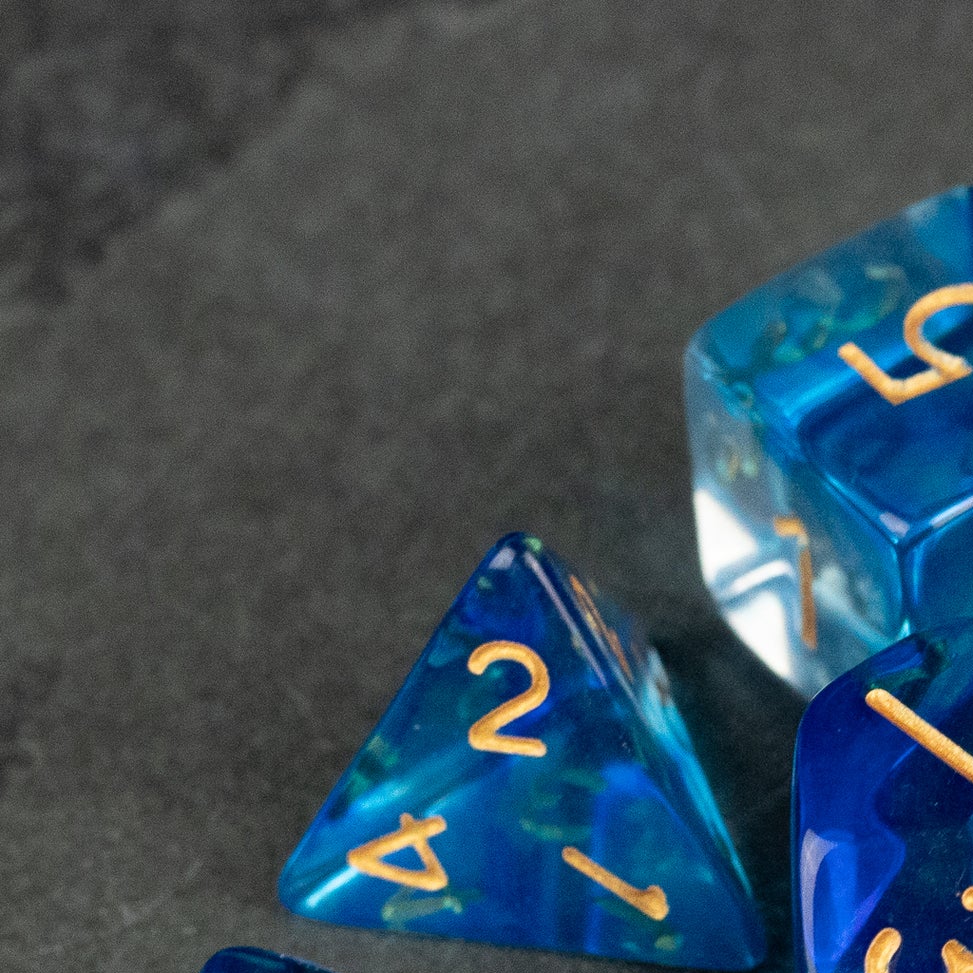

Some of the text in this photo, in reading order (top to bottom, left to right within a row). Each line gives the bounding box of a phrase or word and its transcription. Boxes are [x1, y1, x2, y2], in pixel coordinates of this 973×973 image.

[467, 639, 551, 758] 2
[346, 810, 448, 892] 4
[561, 845, 669, 921] 1
